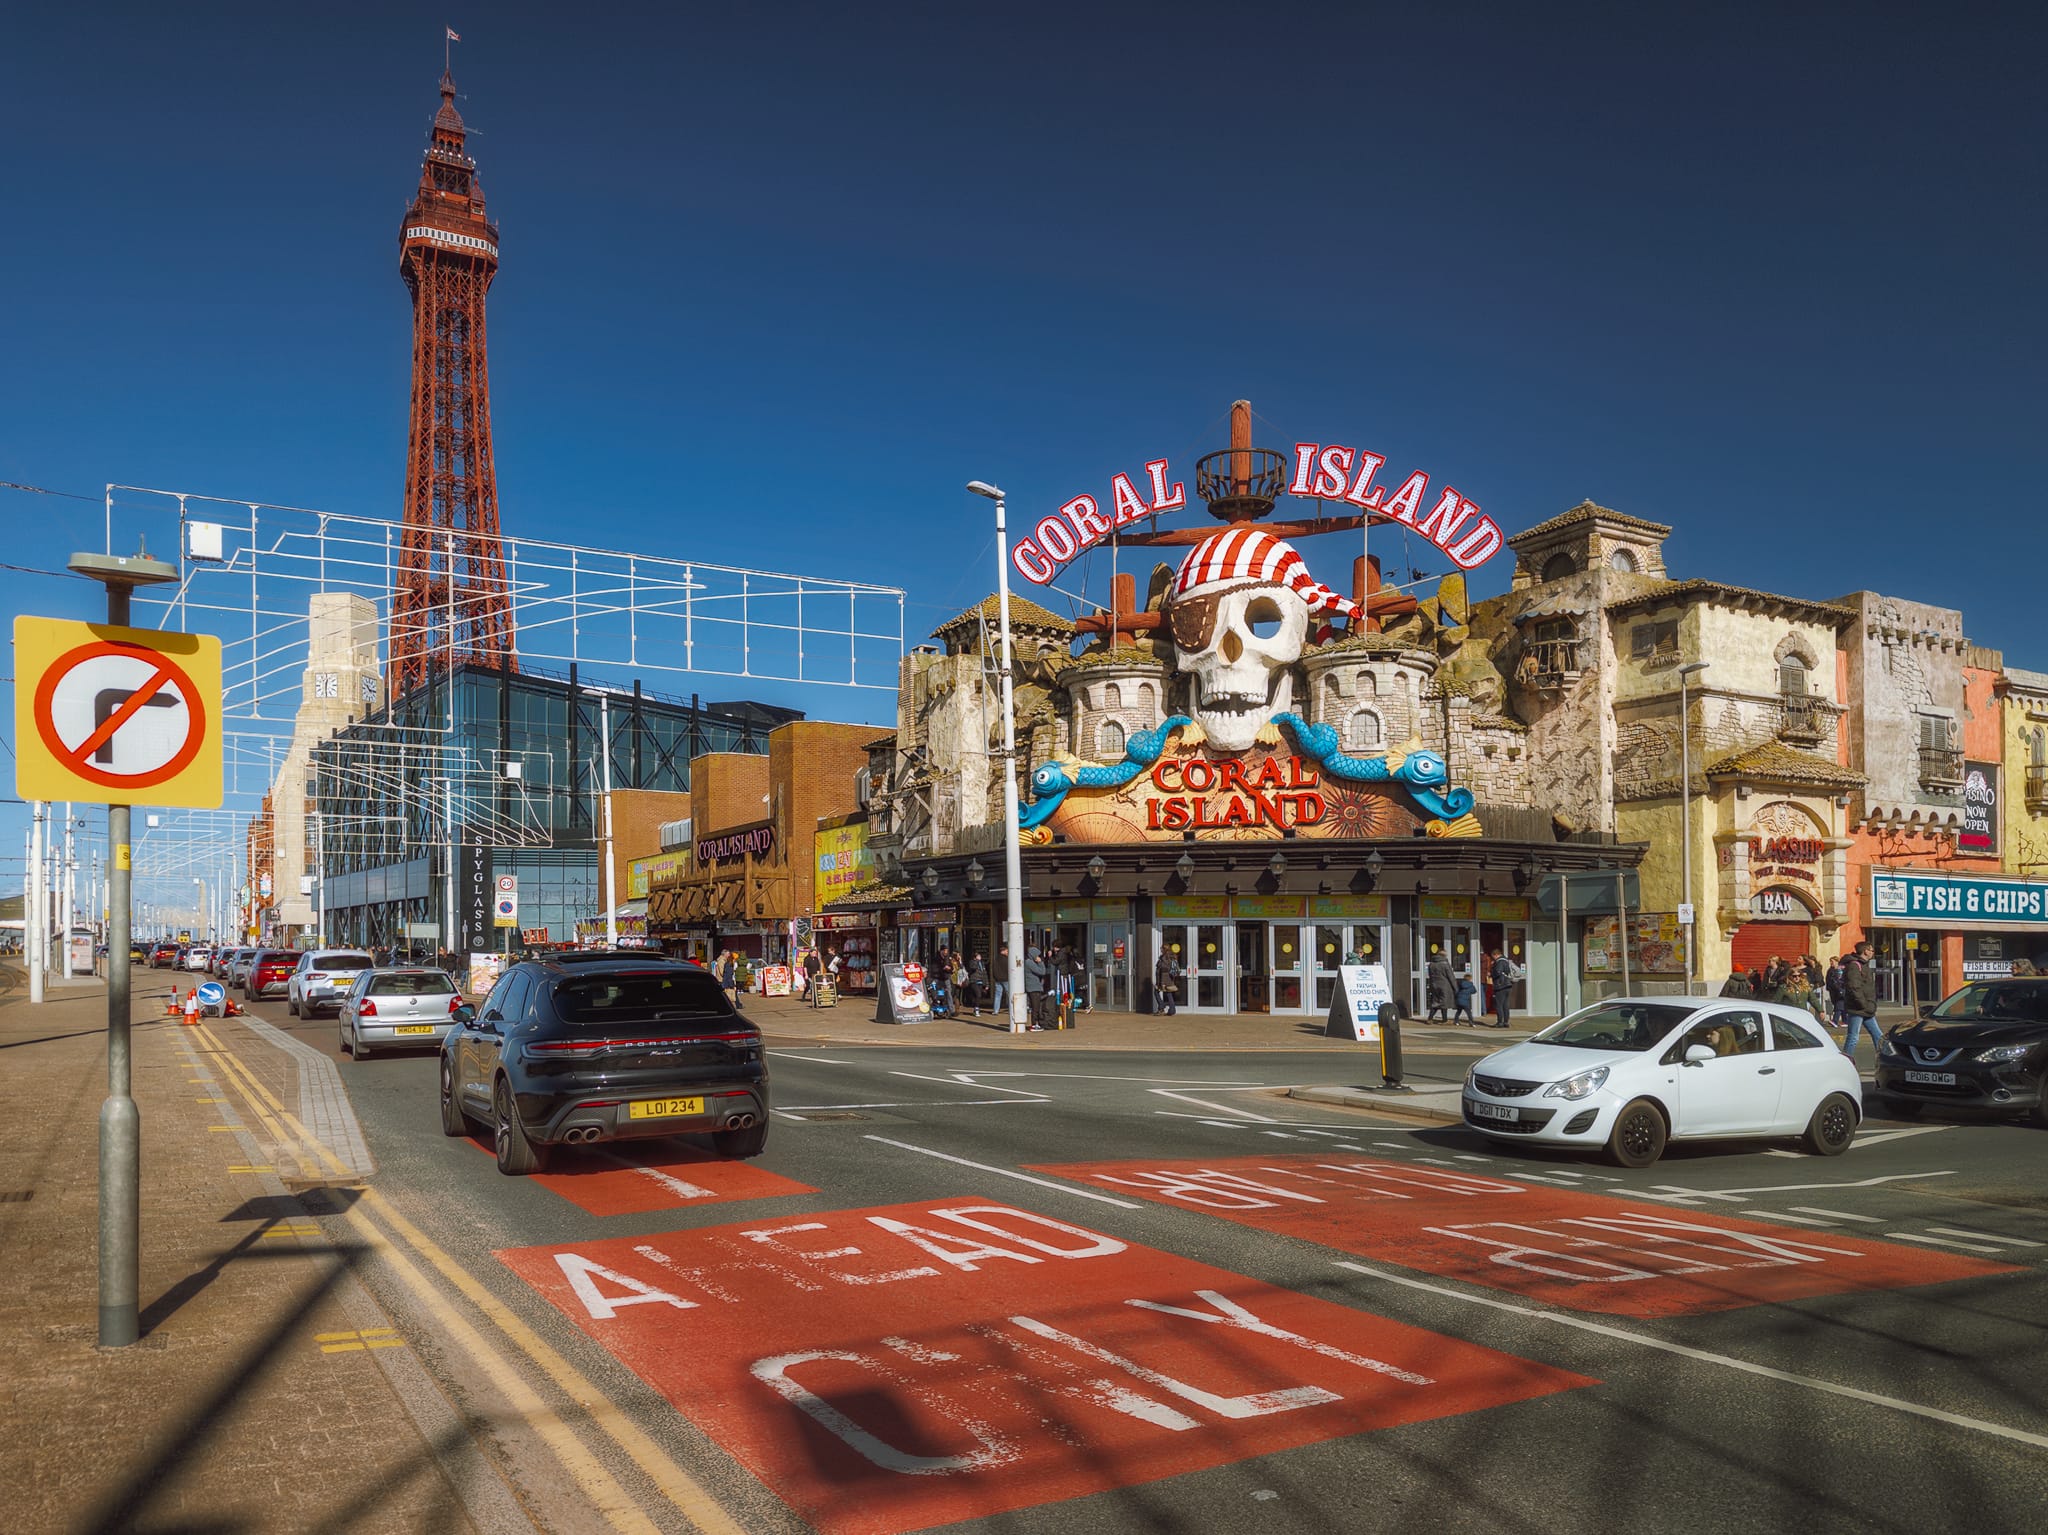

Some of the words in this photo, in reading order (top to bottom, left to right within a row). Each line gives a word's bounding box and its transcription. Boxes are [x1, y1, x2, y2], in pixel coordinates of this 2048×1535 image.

[1012, 457, 1186, 585] CORAL
[1289, 442, 1504, 570] ISLAND
[1151, 756, 1320, 793] CORAL
[1146, 789, 1327, 830] ISLAND
[1965, 788, 1995, 805] ASINO
[1966, 805, 1987, 818] NOW
[1964, 819, 1990, 833] OPEN
[698, 835, 730, 861] CORAL
[731, 828, 771, 854] ISLAND
[1748, 836, 1824, 862] FLAGSHIP
[474, 836, 484, 931] SPYGLASS
[1764, 891, 1792, 911] BAR
[1912, 886, 1961, 911] FISH
[1966, 889, 1979, 911] &
[1983, 889, 2040, 915] CHIPS
[1967, 962, 1985, 971] FISH
[625, 1039, 700, 1047] PORSCHE
[670, 1099, 696, 1114] 234
[1495, 1107, 1512, 1120] TDX
[1421, 1212, 1867, 1283] KEEP
[553, 1206, 1130, 1320] AHEAD
